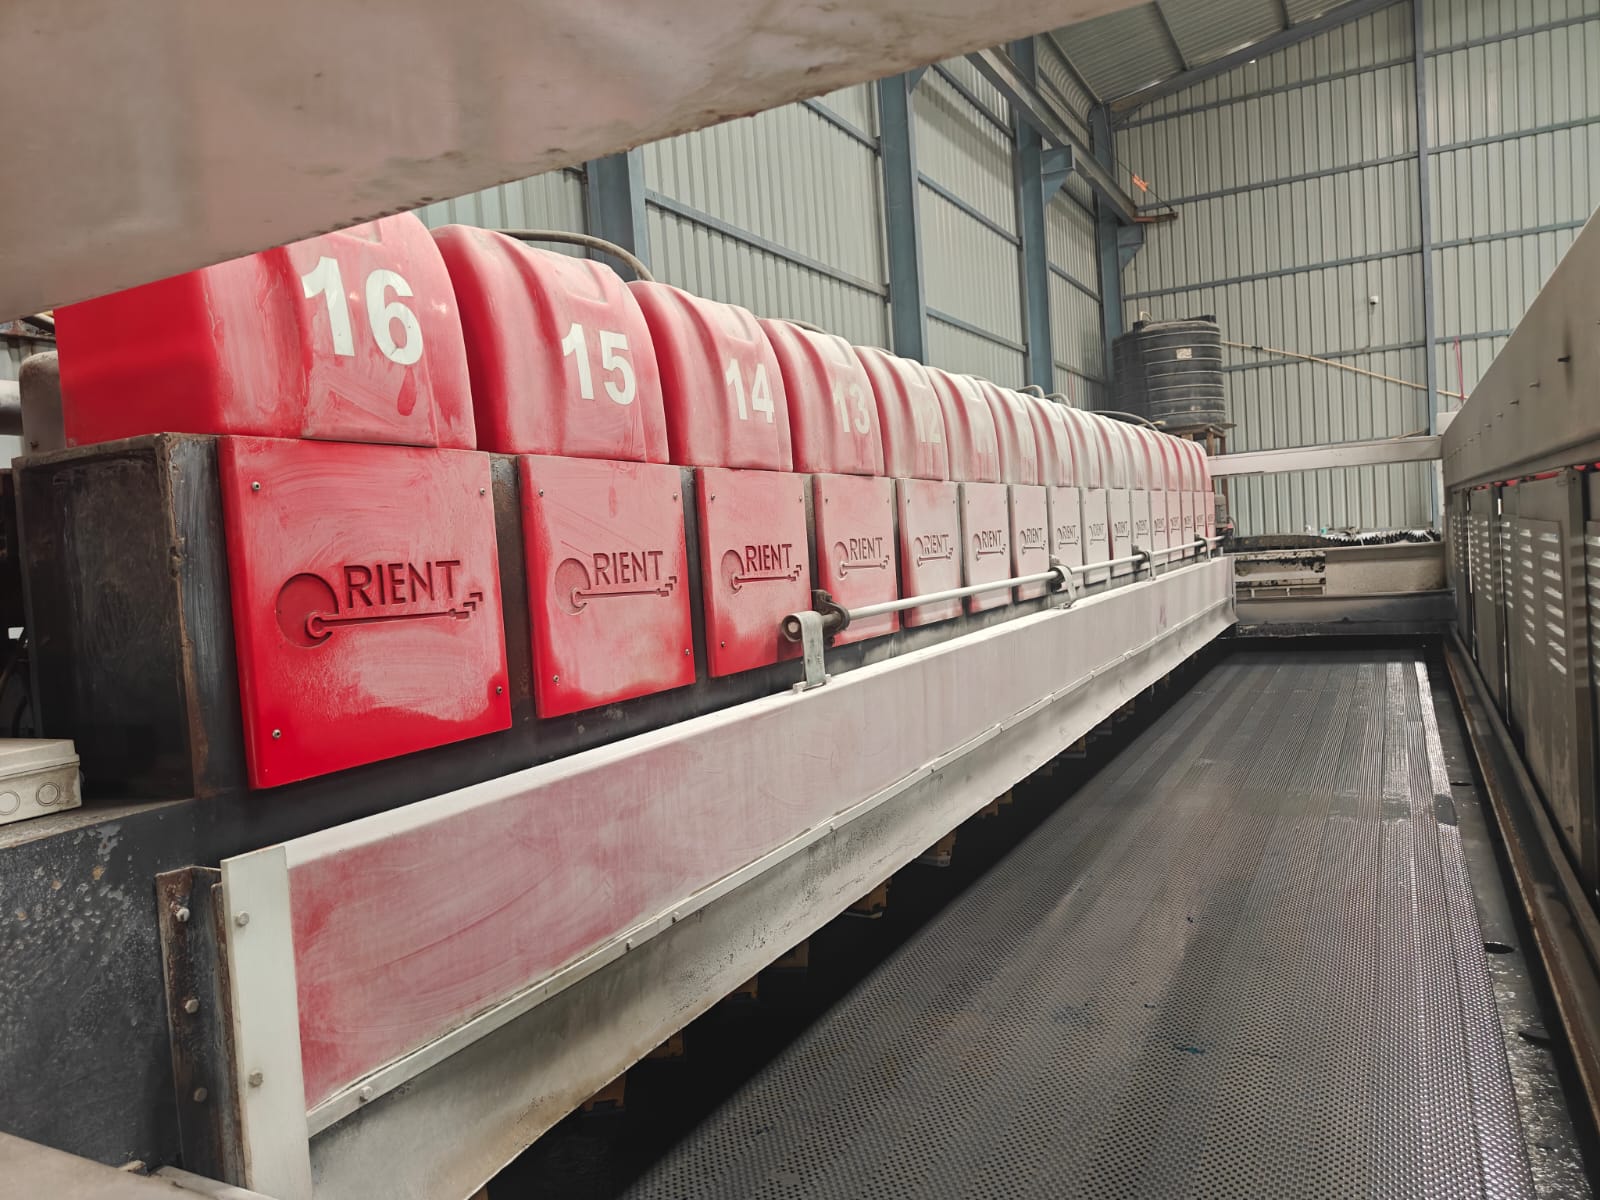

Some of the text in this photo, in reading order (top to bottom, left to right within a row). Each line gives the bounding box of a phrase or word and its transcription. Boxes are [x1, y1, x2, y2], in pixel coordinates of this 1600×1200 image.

[301, 256, 423, 366] 16
[562, 323, 636, 405] 15
[726, 358, 775, 424] 14
[833, 379, 870, 434] 13
